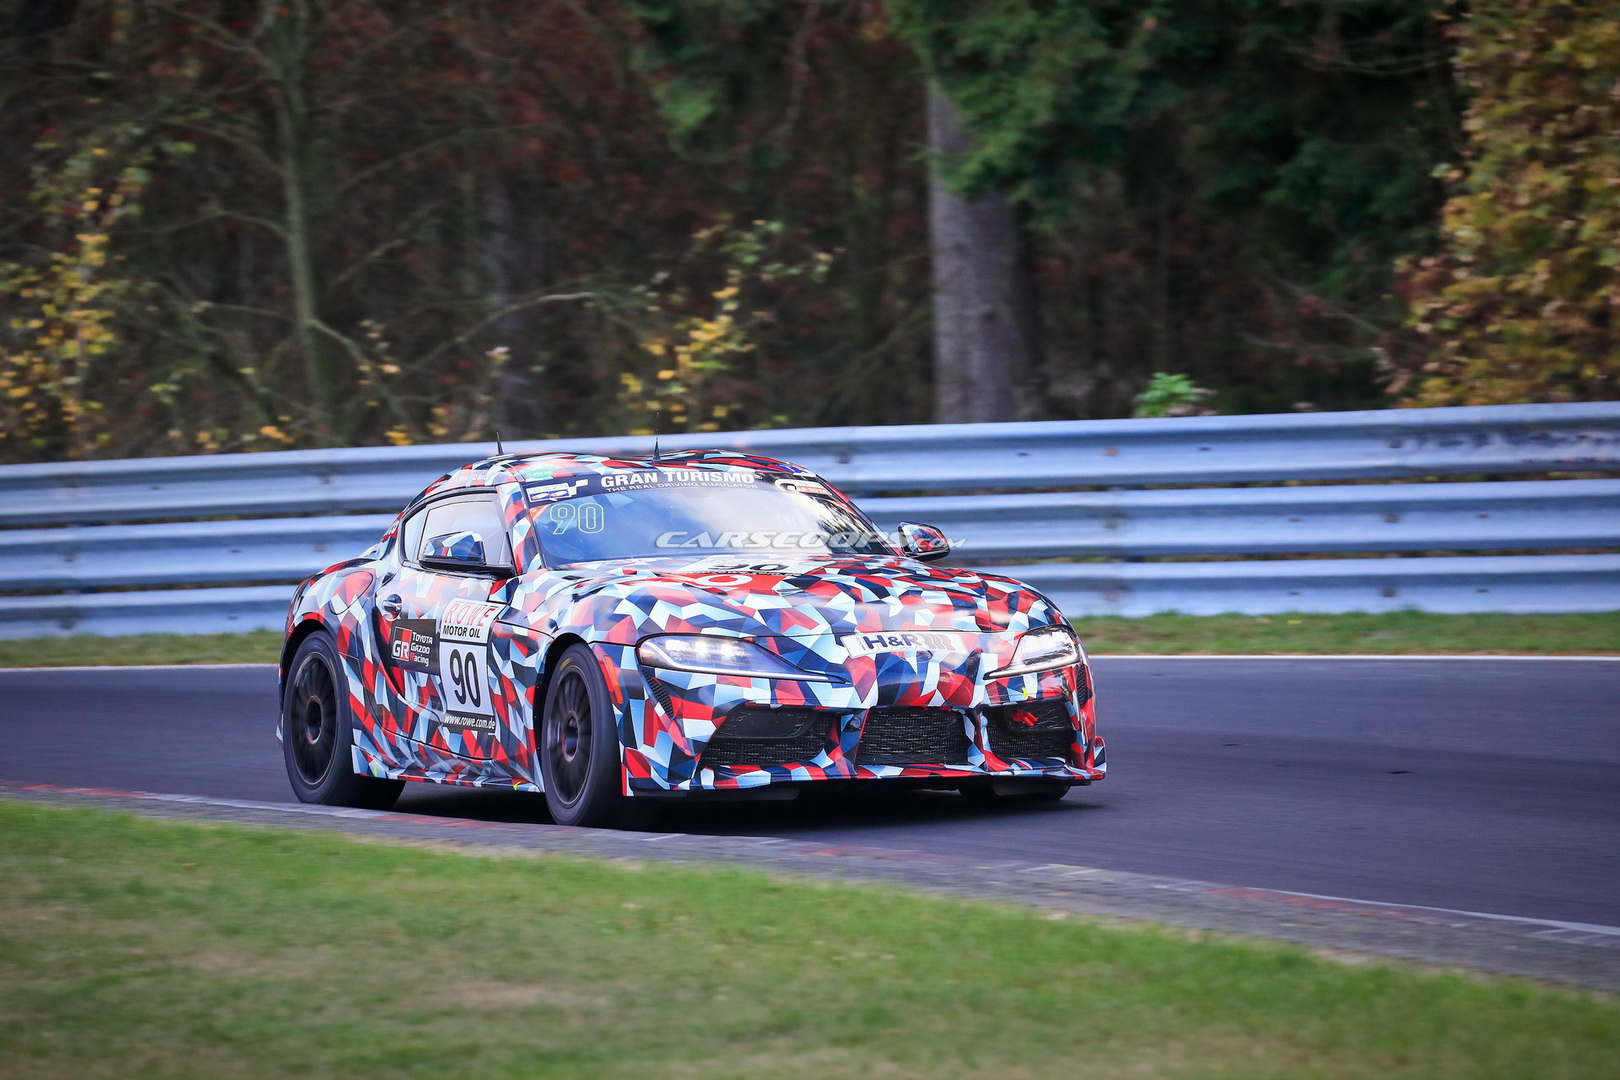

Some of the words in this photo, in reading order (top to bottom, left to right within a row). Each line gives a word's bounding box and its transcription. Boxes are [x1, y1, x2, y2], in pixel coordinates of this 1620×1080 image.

[600, 472, 658, 488] GRAN
[549, 502, 605, 535] 90
[445, 603, 495, 627] ROWE
[412, 632, 433, 645] TOYOTA
[443, 625, 468, 637] MOTOR
[469, 627, 481, 639] OIL
[393, 639, 410, 660] GR
[862, 633, 922, 650] H&R
[409, 652, 429, 667] Racing
[449, 648, 481, 708] 90
[444, 714, 496, 730] www.rowe.com.de
